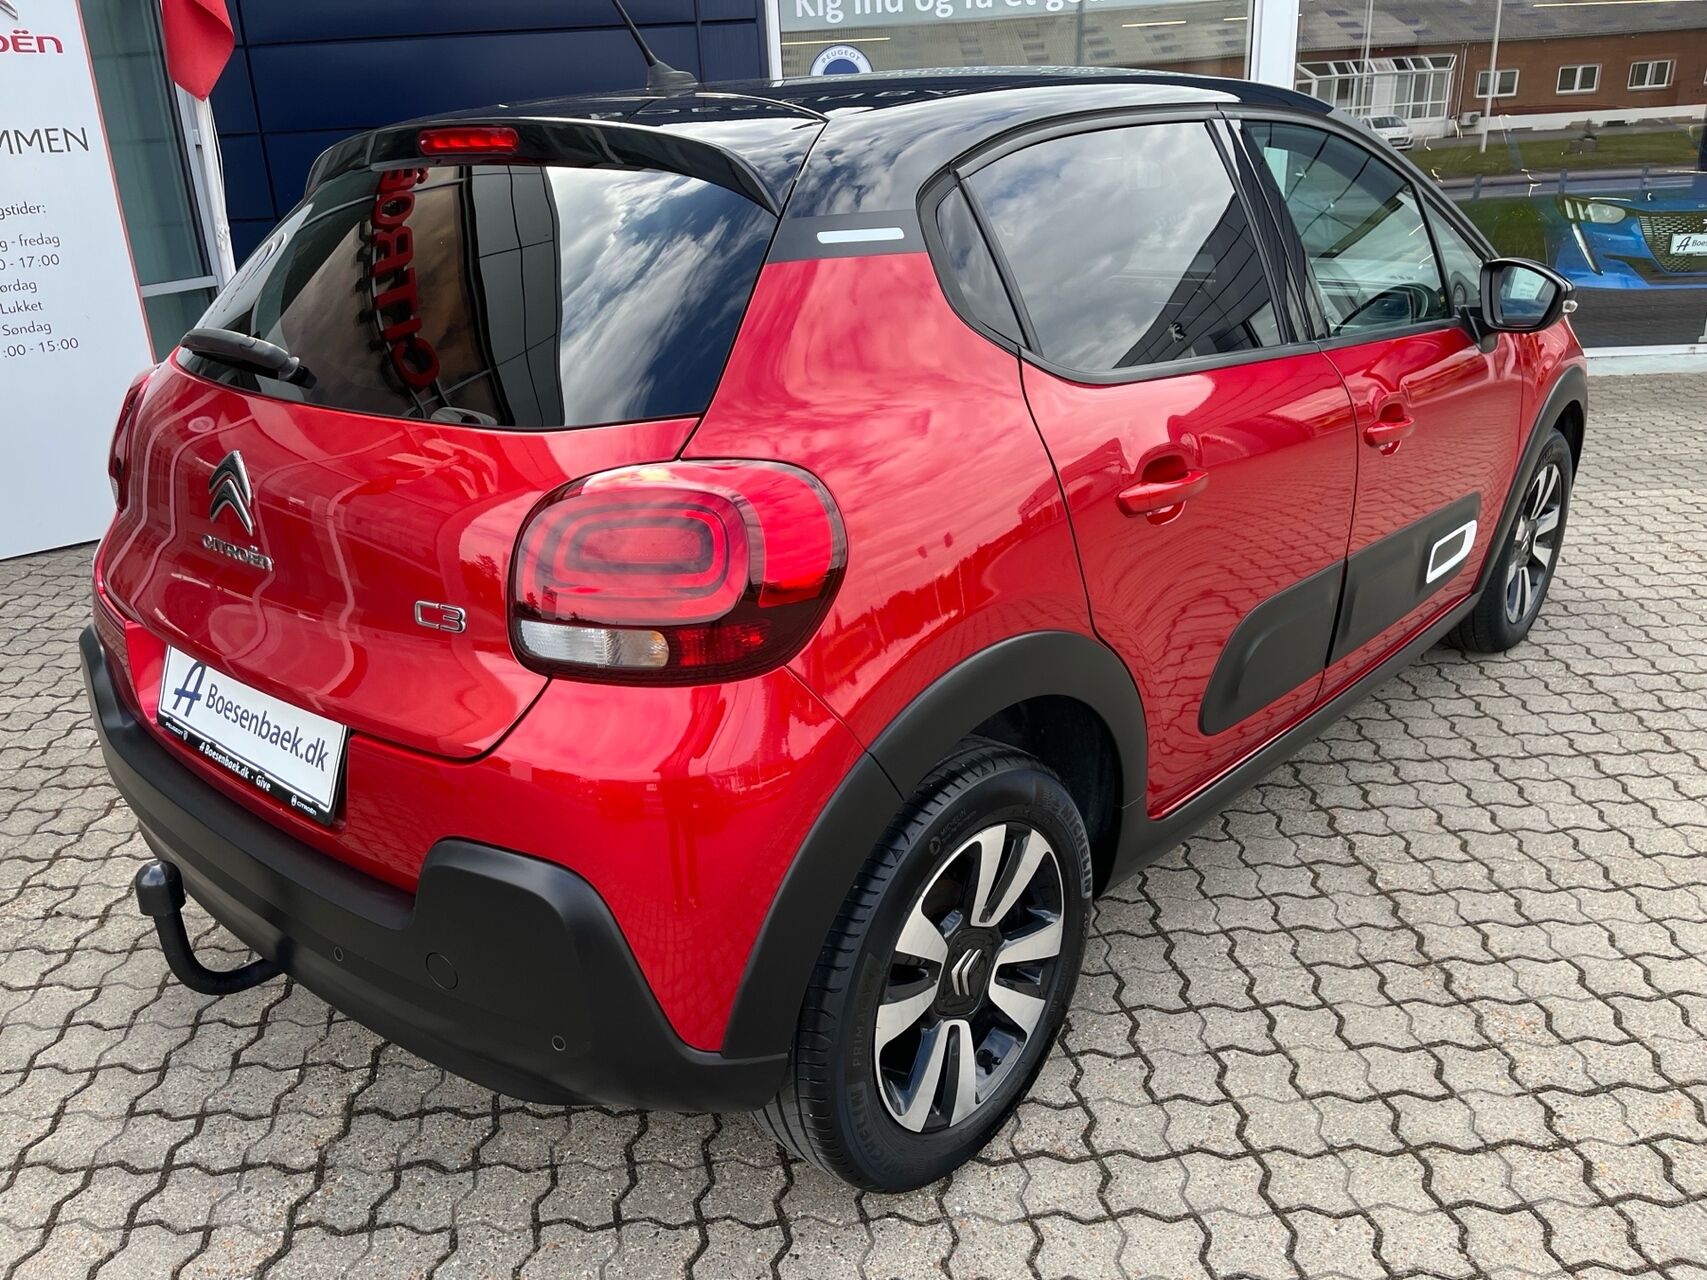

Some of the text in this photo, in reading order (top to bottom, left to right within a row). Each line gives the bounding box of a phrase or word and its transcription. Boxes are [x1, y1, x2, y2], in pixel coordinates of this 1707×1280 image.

[821, 49, 861, 64] PEUGEOT
[19, 233, 61, 248] fredag
[19, 254, 60, 268] 17:00
[0, 300, 44, 315] Lukket
[2, 321, 52, 336] Søndag
[39, 337, 79, 353] 15:00
[414, 600, 467, 633] C3
[205, 683, 329, 772] Boesenbaek.dk
[204, 744, 250, 779] Boesenbaek.dk
[255, 775, 271, 792] Give
[1059, 803, 1093, 893] MICHELIN
